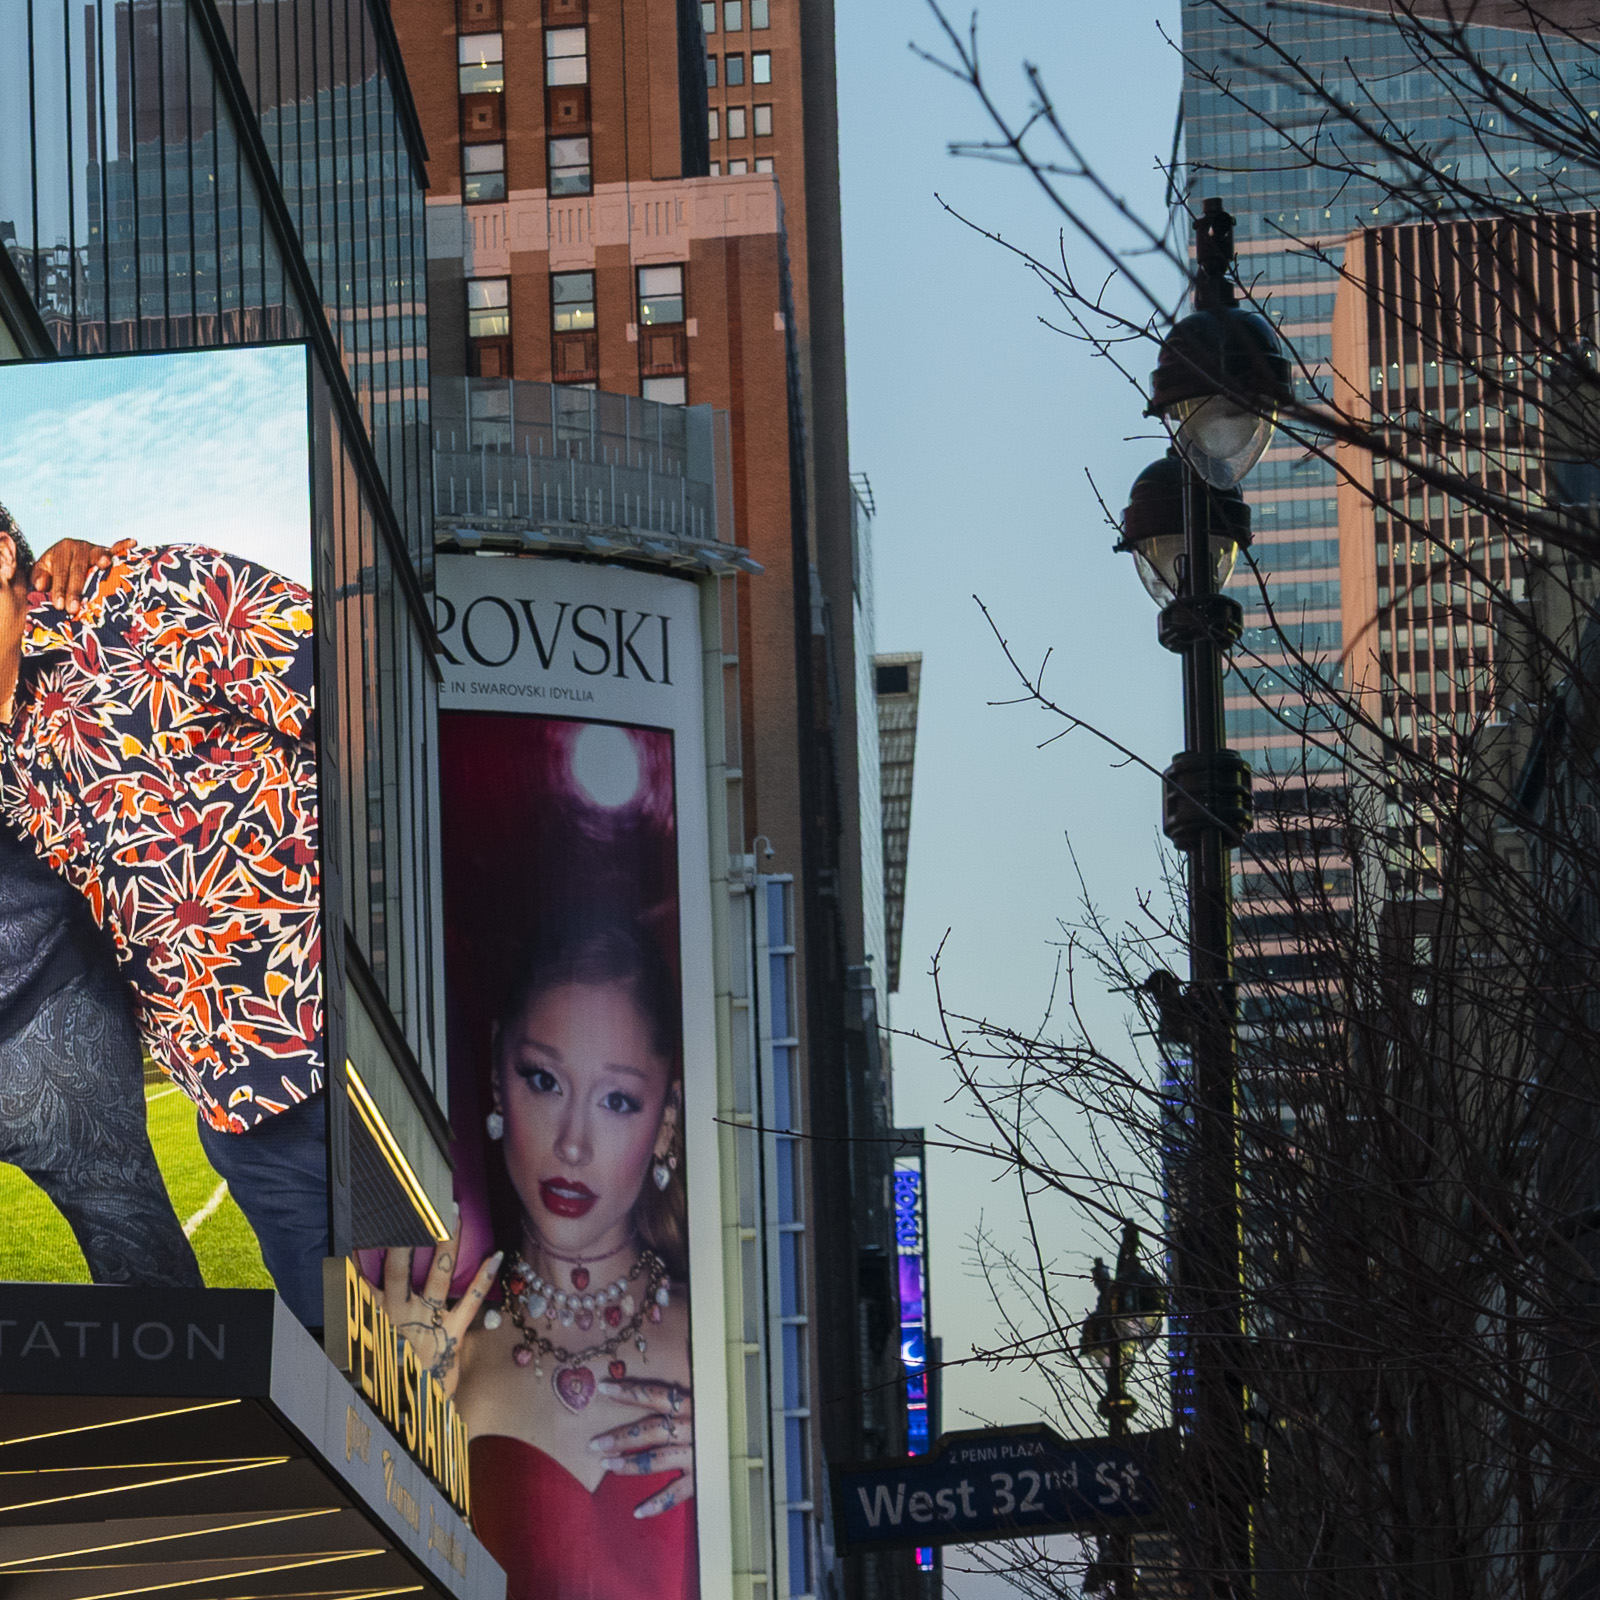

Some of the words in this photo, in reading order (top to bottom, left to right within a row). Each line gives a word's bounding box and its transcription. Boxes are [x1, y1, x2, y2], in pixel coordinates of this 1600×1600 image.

[434, 595, 674, 686] ROVSKI
[451, 682, 465, 693] IN
[470, 682, 546, 699] SWAROVSKI
[549, 686, 594, 702] IDYLLIA
[893, 1171, 920, 1247] ROKU
[345, 1256, 400, 1433] PENN
[403, 1339, 470, 1517] STATION
[961, 1449, 997, 1462] PENN
[1001, 1443, 1045, 1460] PLAZA
[858, 1480, 977, 1527] West
[990, 1462, 1078, 1517] 32nd
[1095, 1459, 1141, 1505] St
